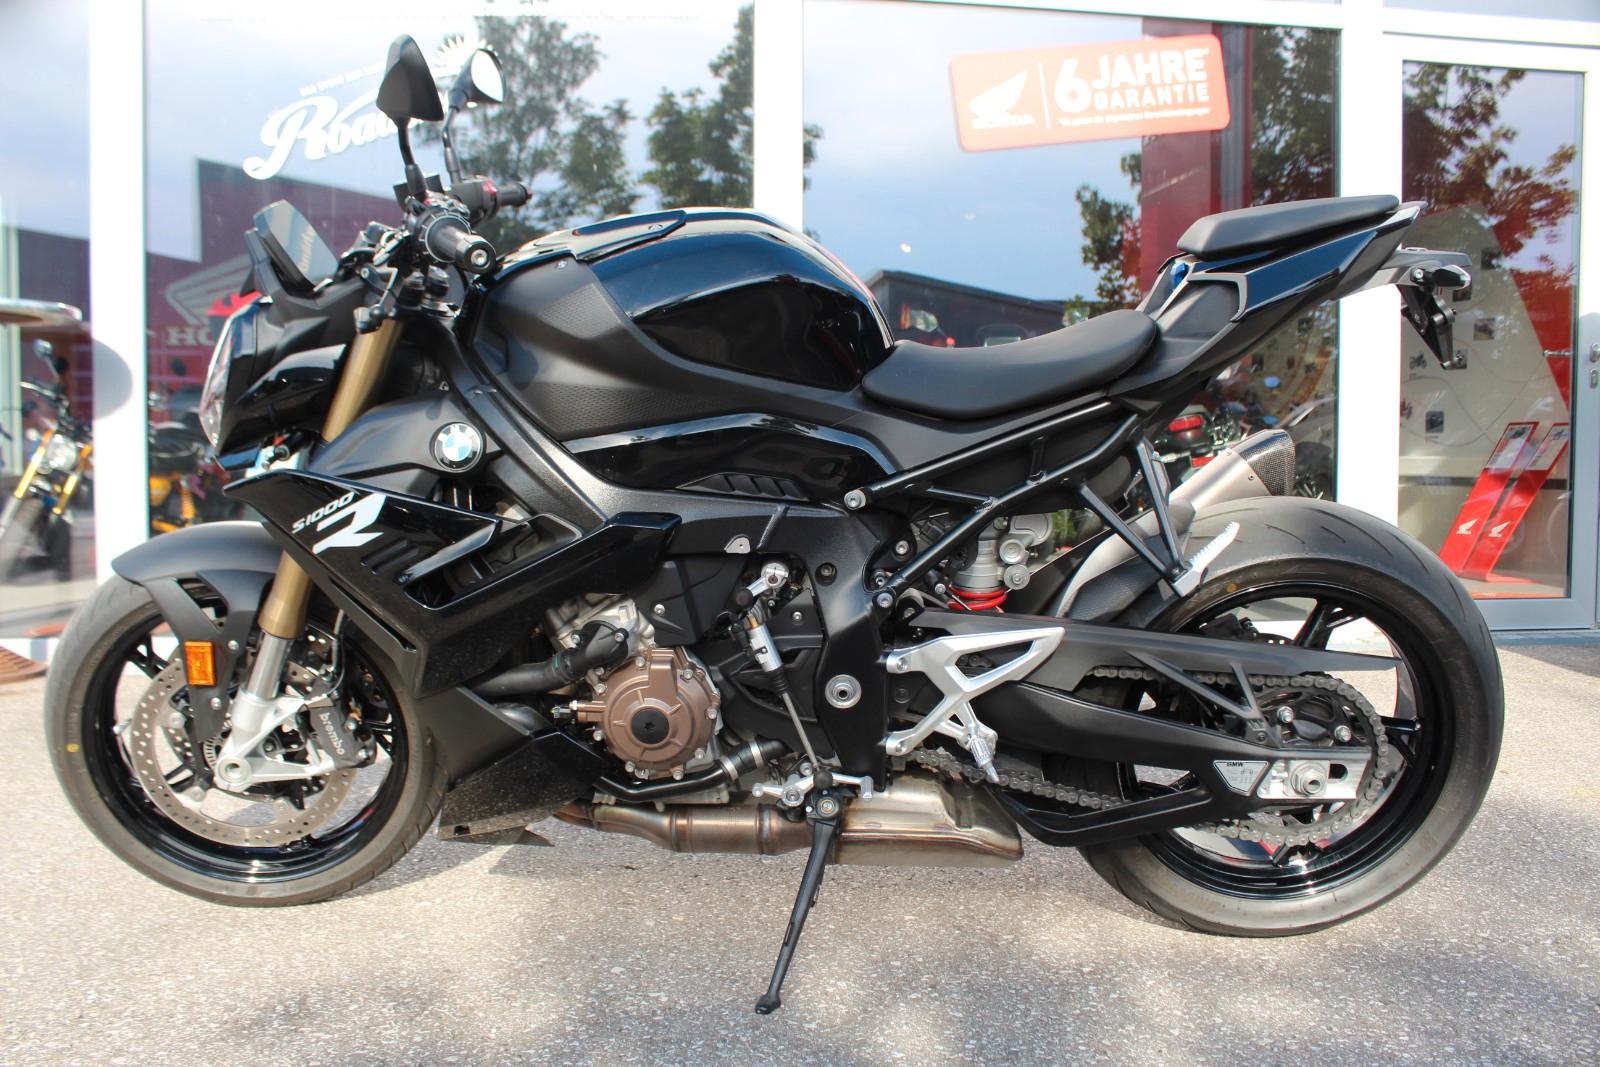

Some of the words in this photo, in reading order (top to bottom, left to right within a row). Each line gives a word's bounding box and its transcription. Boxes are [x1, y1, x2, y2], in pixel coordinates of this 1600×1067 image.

[1054, 57, 1091, 113] 6
[1094, 82, 1210, 111] GARANTIE
[291, 491, 355, 534] S1000
[319, 712, 345, 756] brembo
